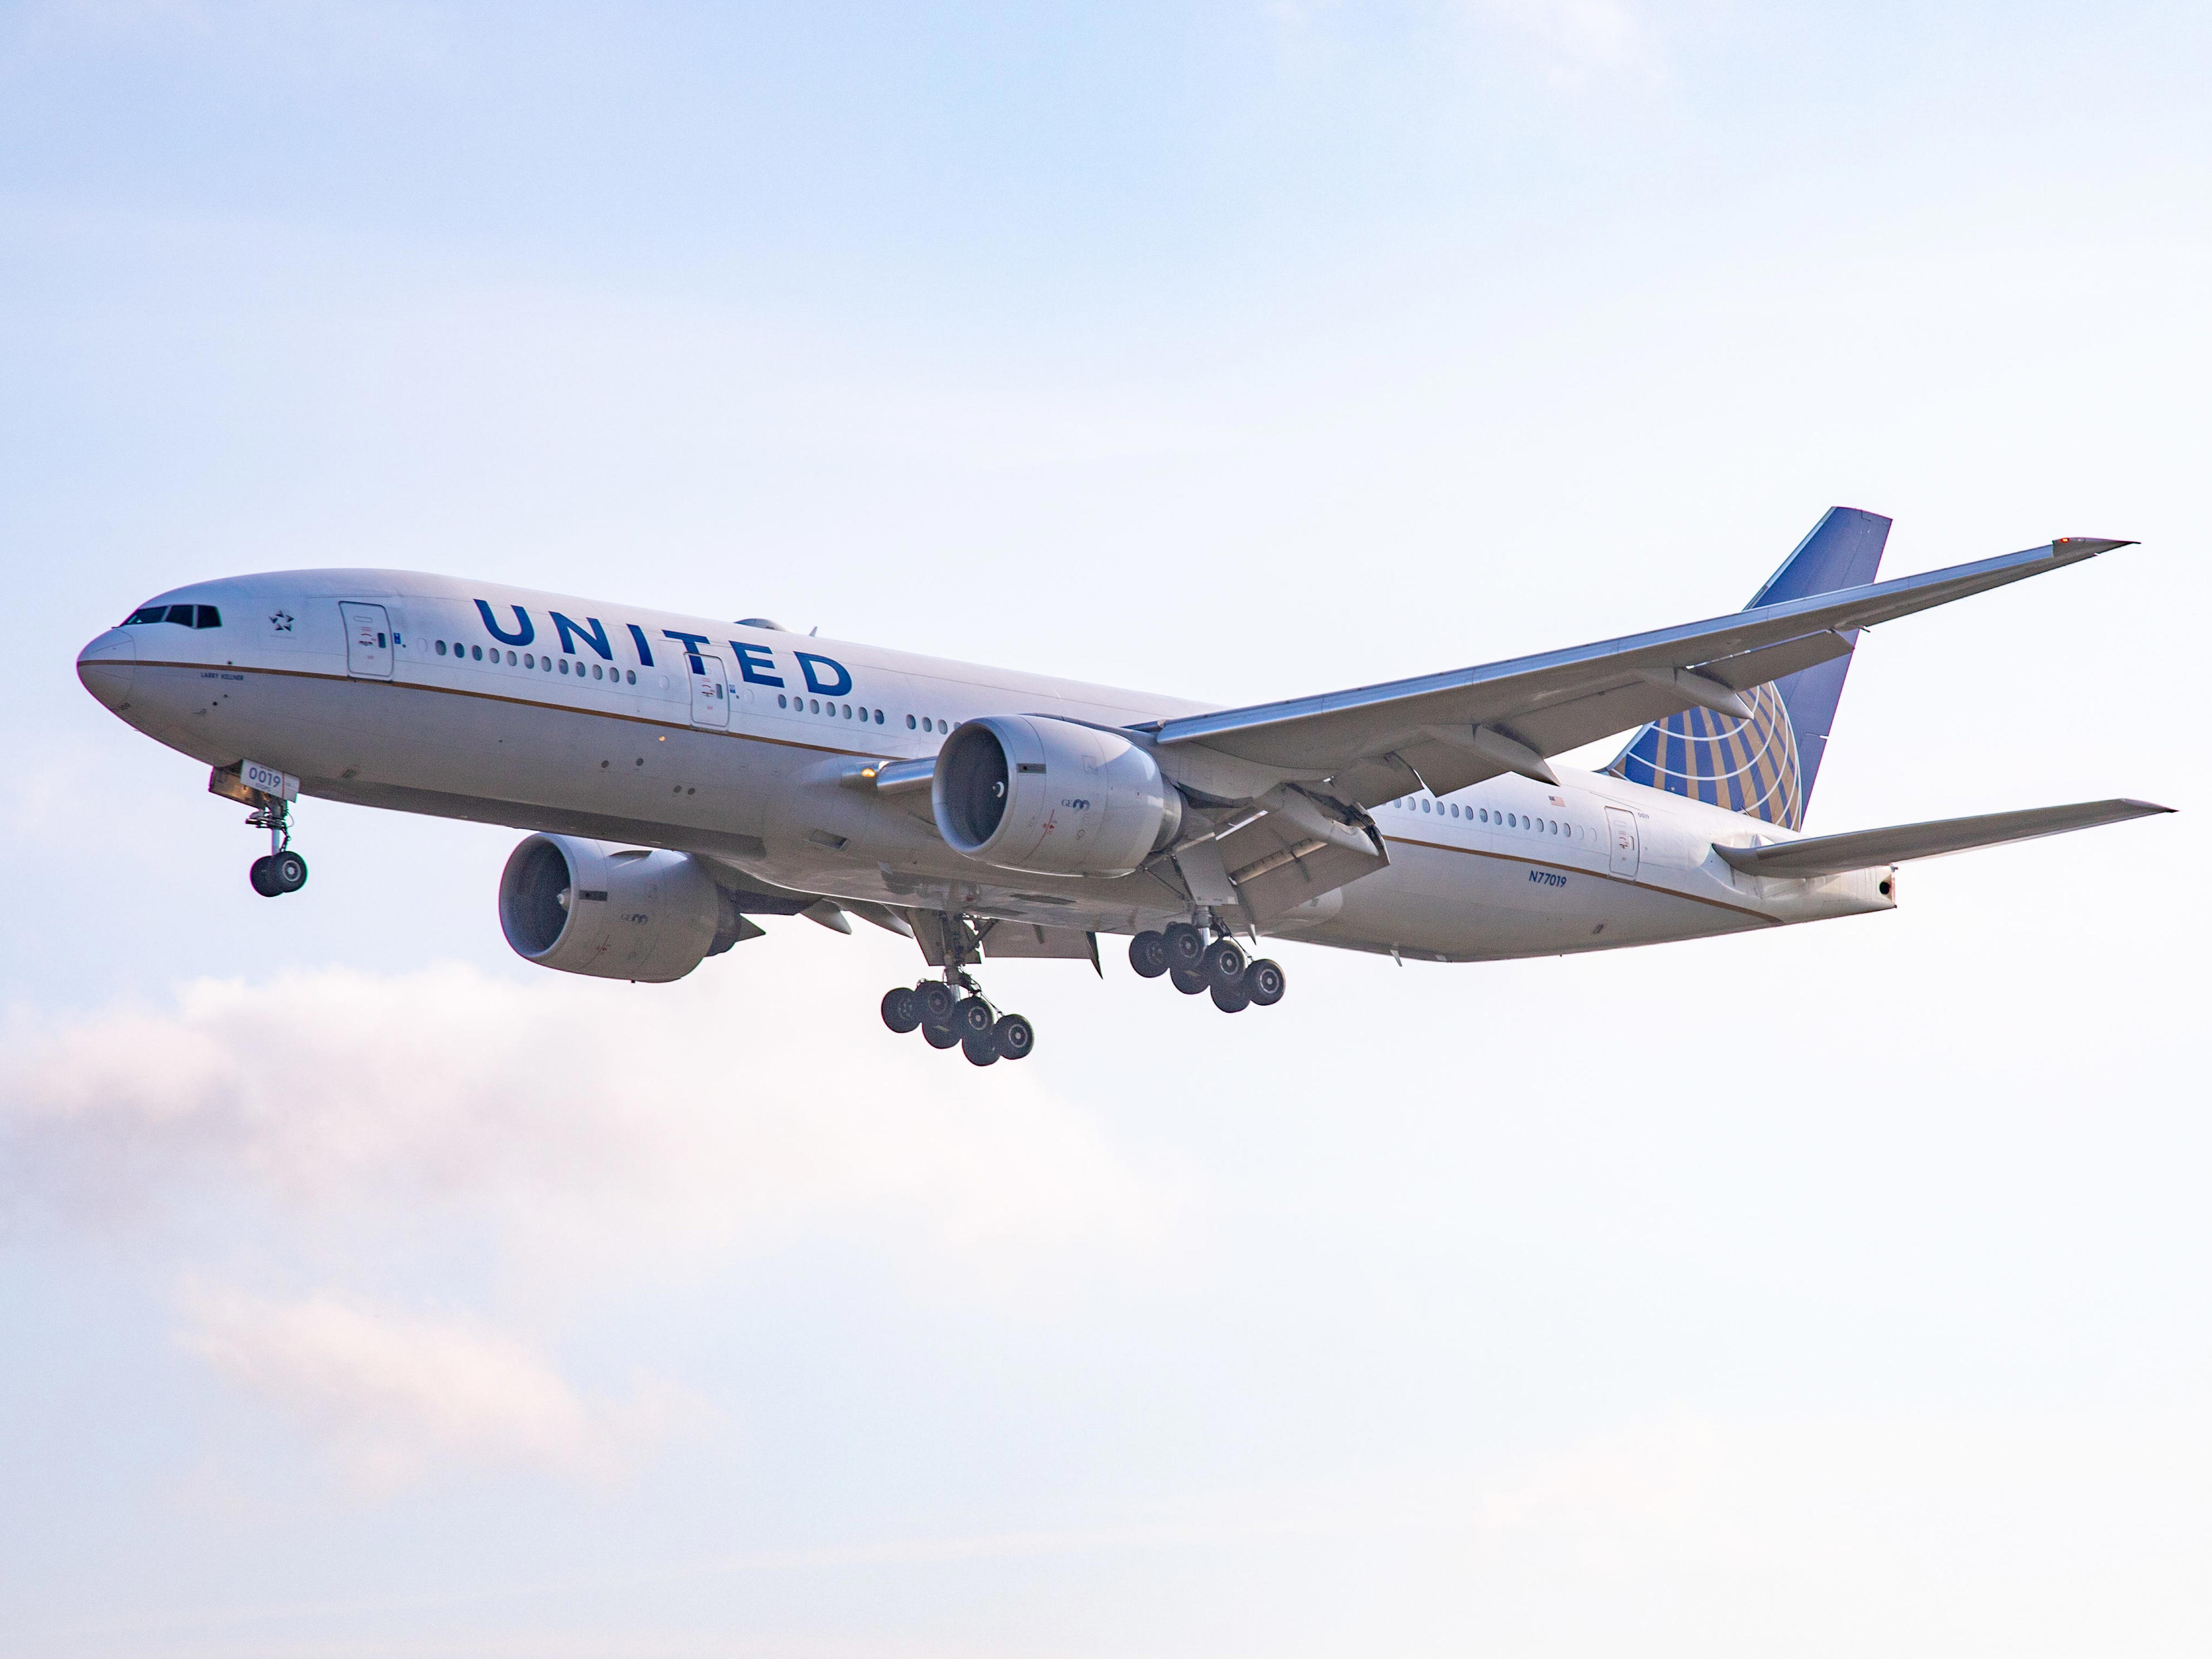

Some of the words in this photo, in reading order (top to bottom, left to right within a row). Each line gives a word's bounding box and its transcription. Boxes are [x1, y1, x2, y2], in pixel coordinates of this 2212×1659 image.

[474, 598, 852, 697] UNITED
[249, 767, 281, 788] 0019
[1529, 870, 1567, 888] N77019
